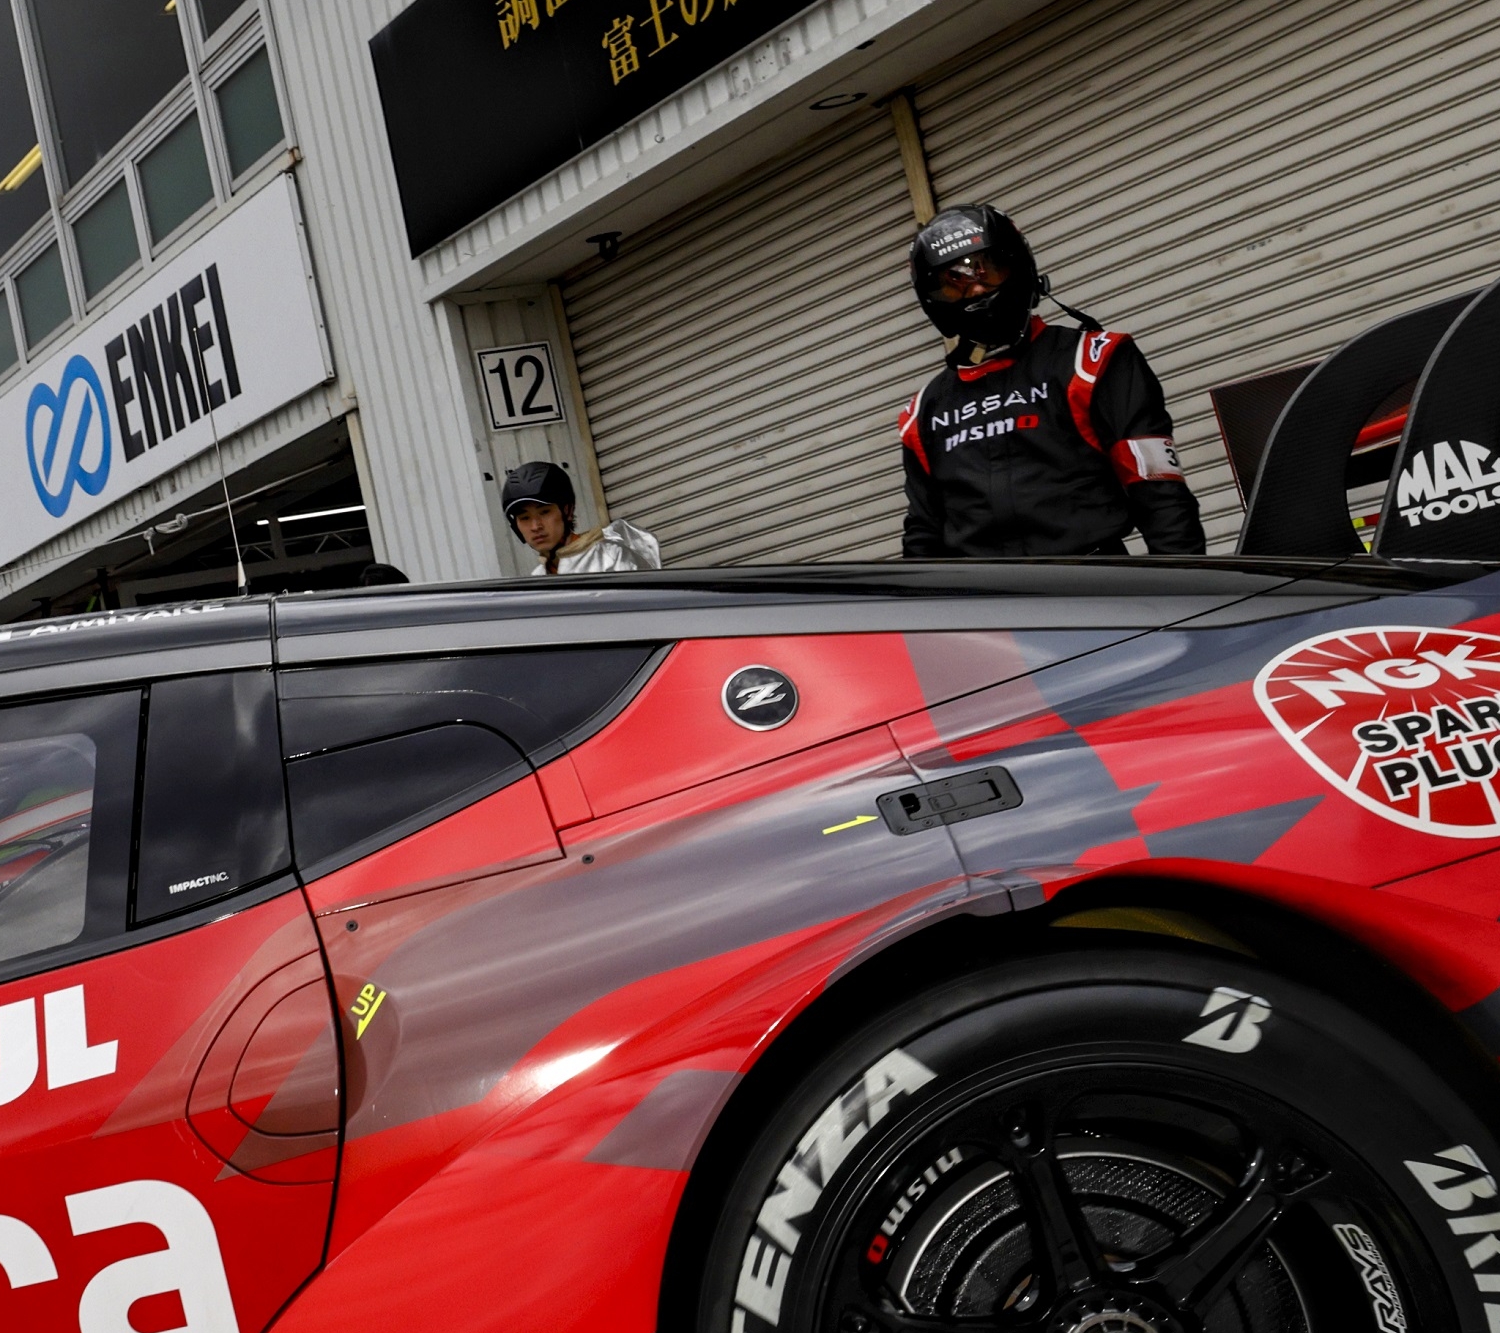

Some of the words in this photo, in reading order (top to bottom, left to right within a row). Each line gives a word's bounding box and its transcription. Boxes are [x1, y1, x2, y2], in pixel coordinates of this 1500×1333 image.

[931, 226, 984, 250] NISSAN
[105, 263, 242, 463] ENKEI
[486, 353, 558, 419] 12
[931, 382, 1048, 430] NISSAN
[945, 414, 1039, 451] nismo
[352, 982, 377, 1017] UP
[866, 1147, 963, 1266] nismo
